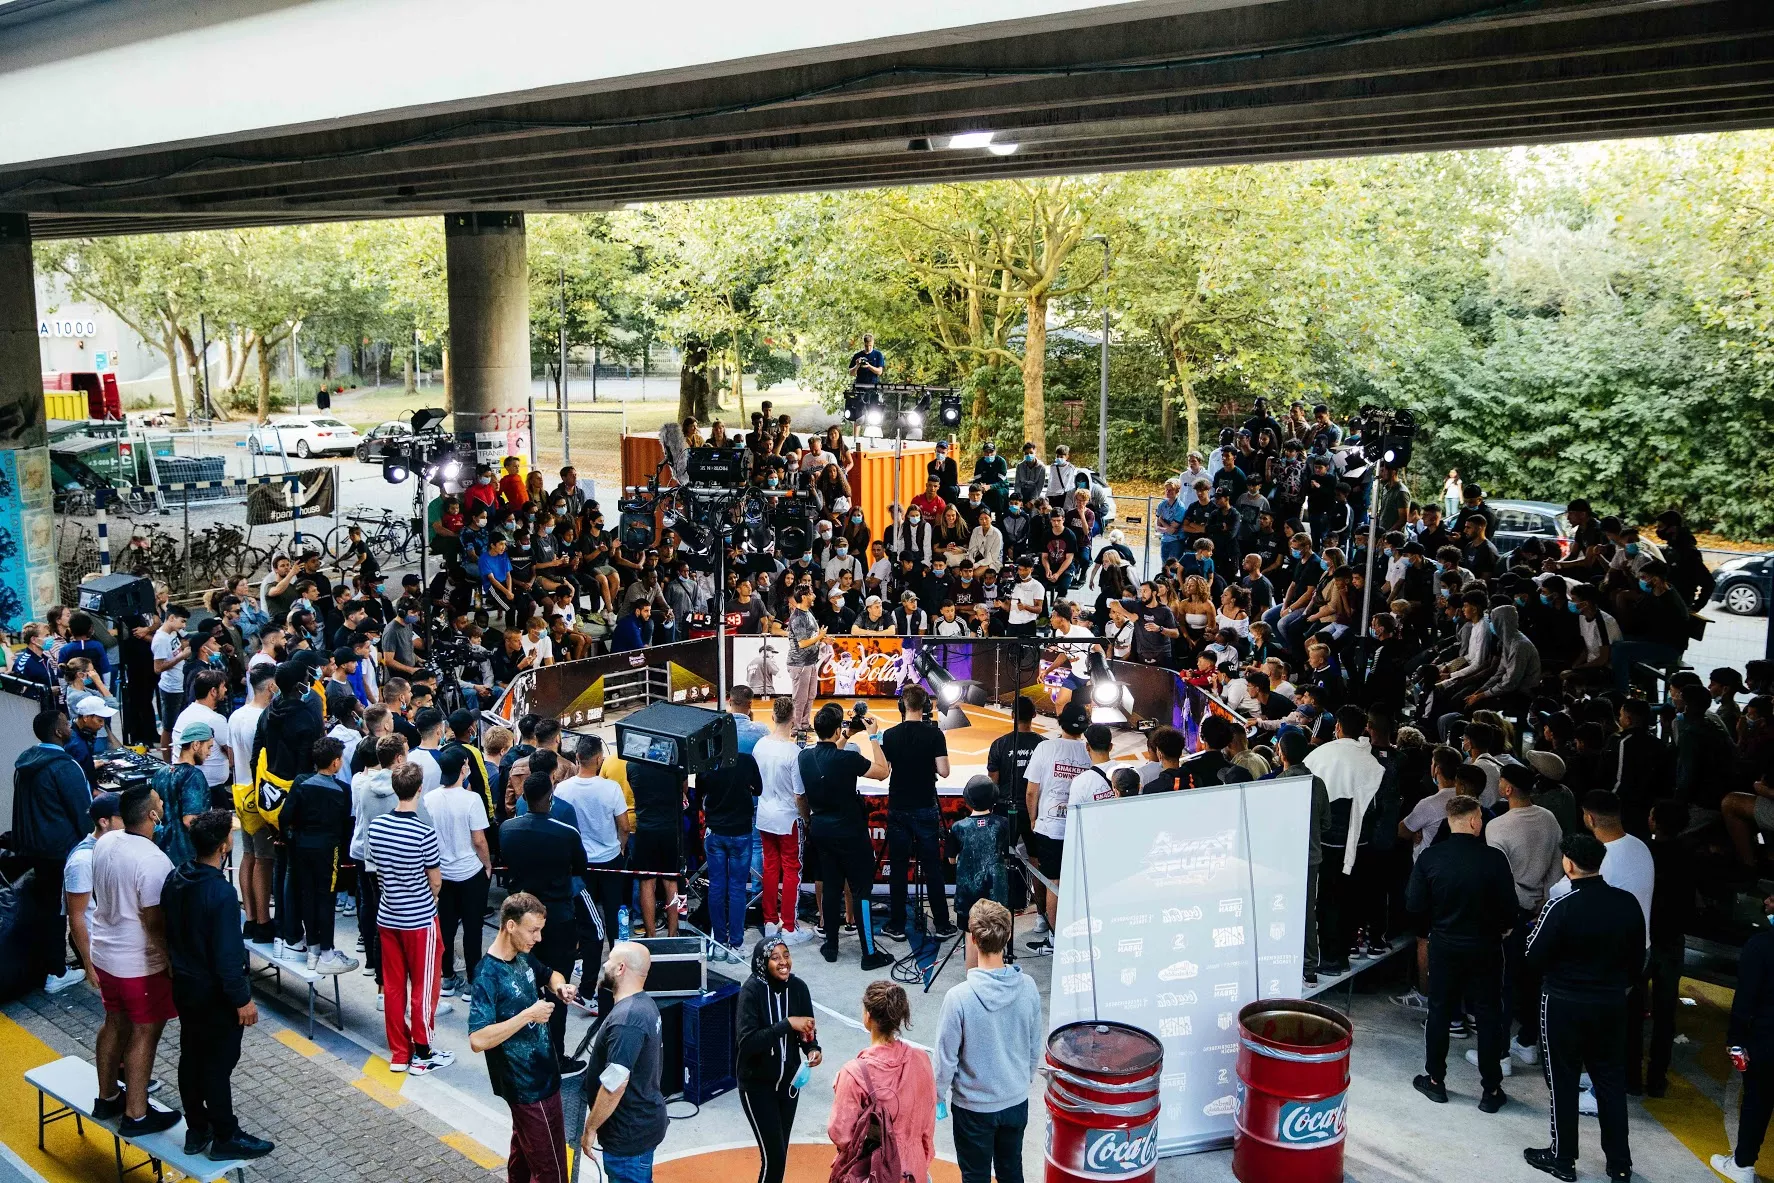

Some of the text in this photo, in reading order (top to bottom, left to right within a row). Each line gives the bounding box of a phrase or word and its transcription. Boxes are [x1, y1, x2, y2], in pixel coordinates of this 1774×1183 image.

[56, 322, 94, 334] 1000
[270, 505, 320, 521] #panhouse
[686, 613, 692, 623] 4
[704, 615, 711, 625] 3
[816, 653, 898, 682] Co-Cola
[1056, 764, 1085, 774] SNACKBA
